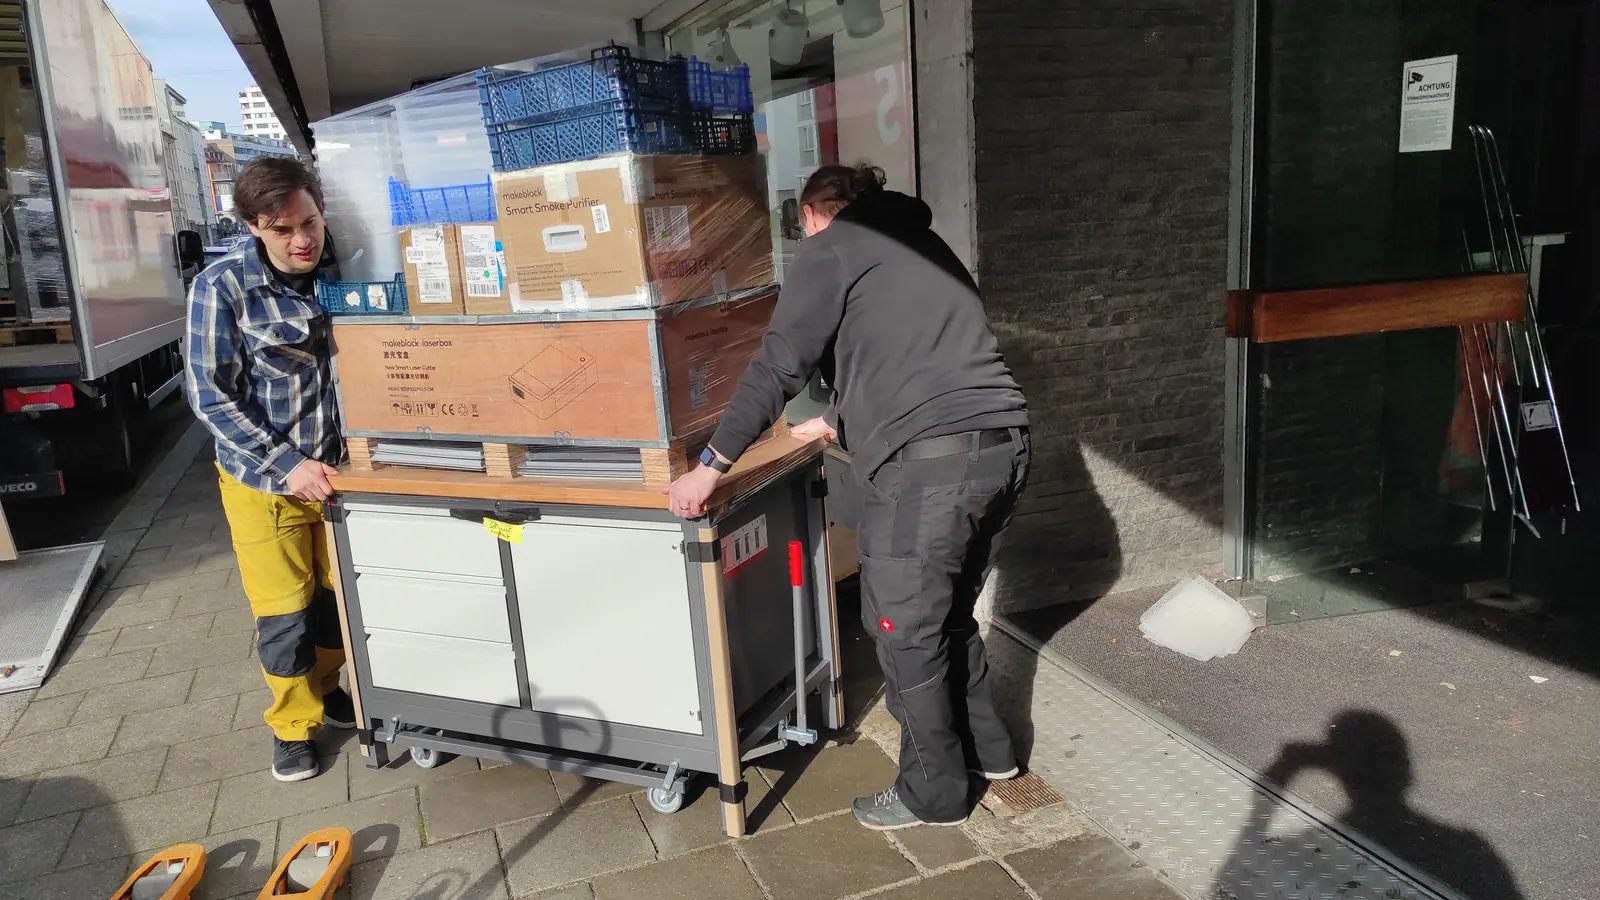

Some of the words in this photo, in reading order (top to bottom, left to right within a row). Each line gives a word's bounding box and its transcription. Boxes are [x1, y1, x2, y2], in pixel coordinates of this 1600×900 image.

[1418, 81, 1451, 92] ACHTUNG
[502, 188, 543, 200] makeblock
[505, 204, 534, 216] Smart
[534, 202, 565, 213] Smoke
[566, 197, 600, 209] Purifier
[382, 339, 420, 347] makeblock
[422, 339, 453, 347] laserbox
[0, 482, 38, 493] VECO
